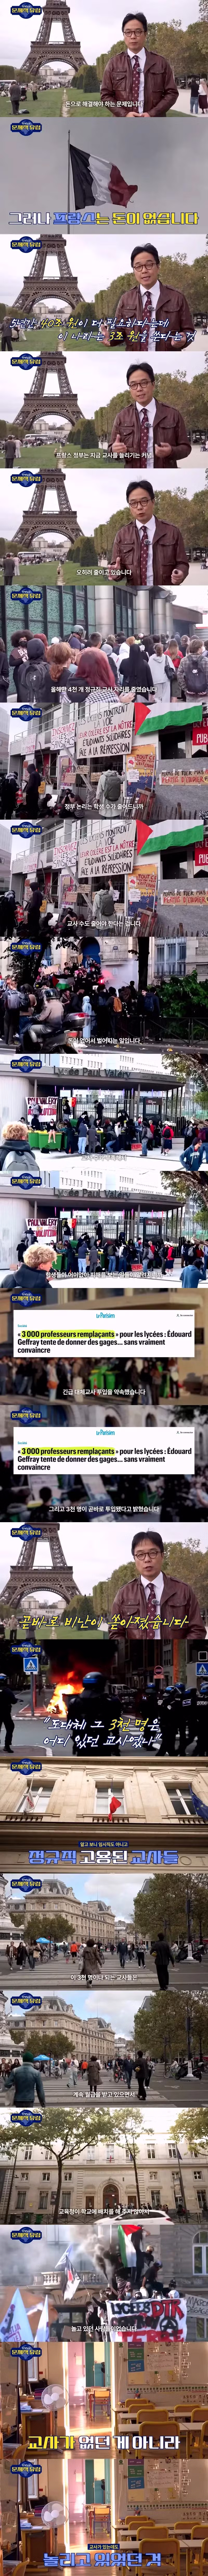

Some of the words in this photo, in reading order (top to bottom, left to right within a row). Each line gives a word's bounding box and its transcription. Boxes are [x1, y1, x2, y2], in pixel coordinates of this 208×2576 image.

[104, 703, 129, 717] MONTRENT
[118, 720, 132, 730] NÔTRE
[51, 740, 63, 749] SANS
[65, 736, 74, 746] FACS
[89, 747, 92, 755] À
[93, 747, 98, 755] LA
[53, 1187, 79, 1198] Lycée
[82, 1189, 101, 1197] Paul
[104, 1190, 130, 1201] Valéry
[151, 2300, 184, 2320] DTR
